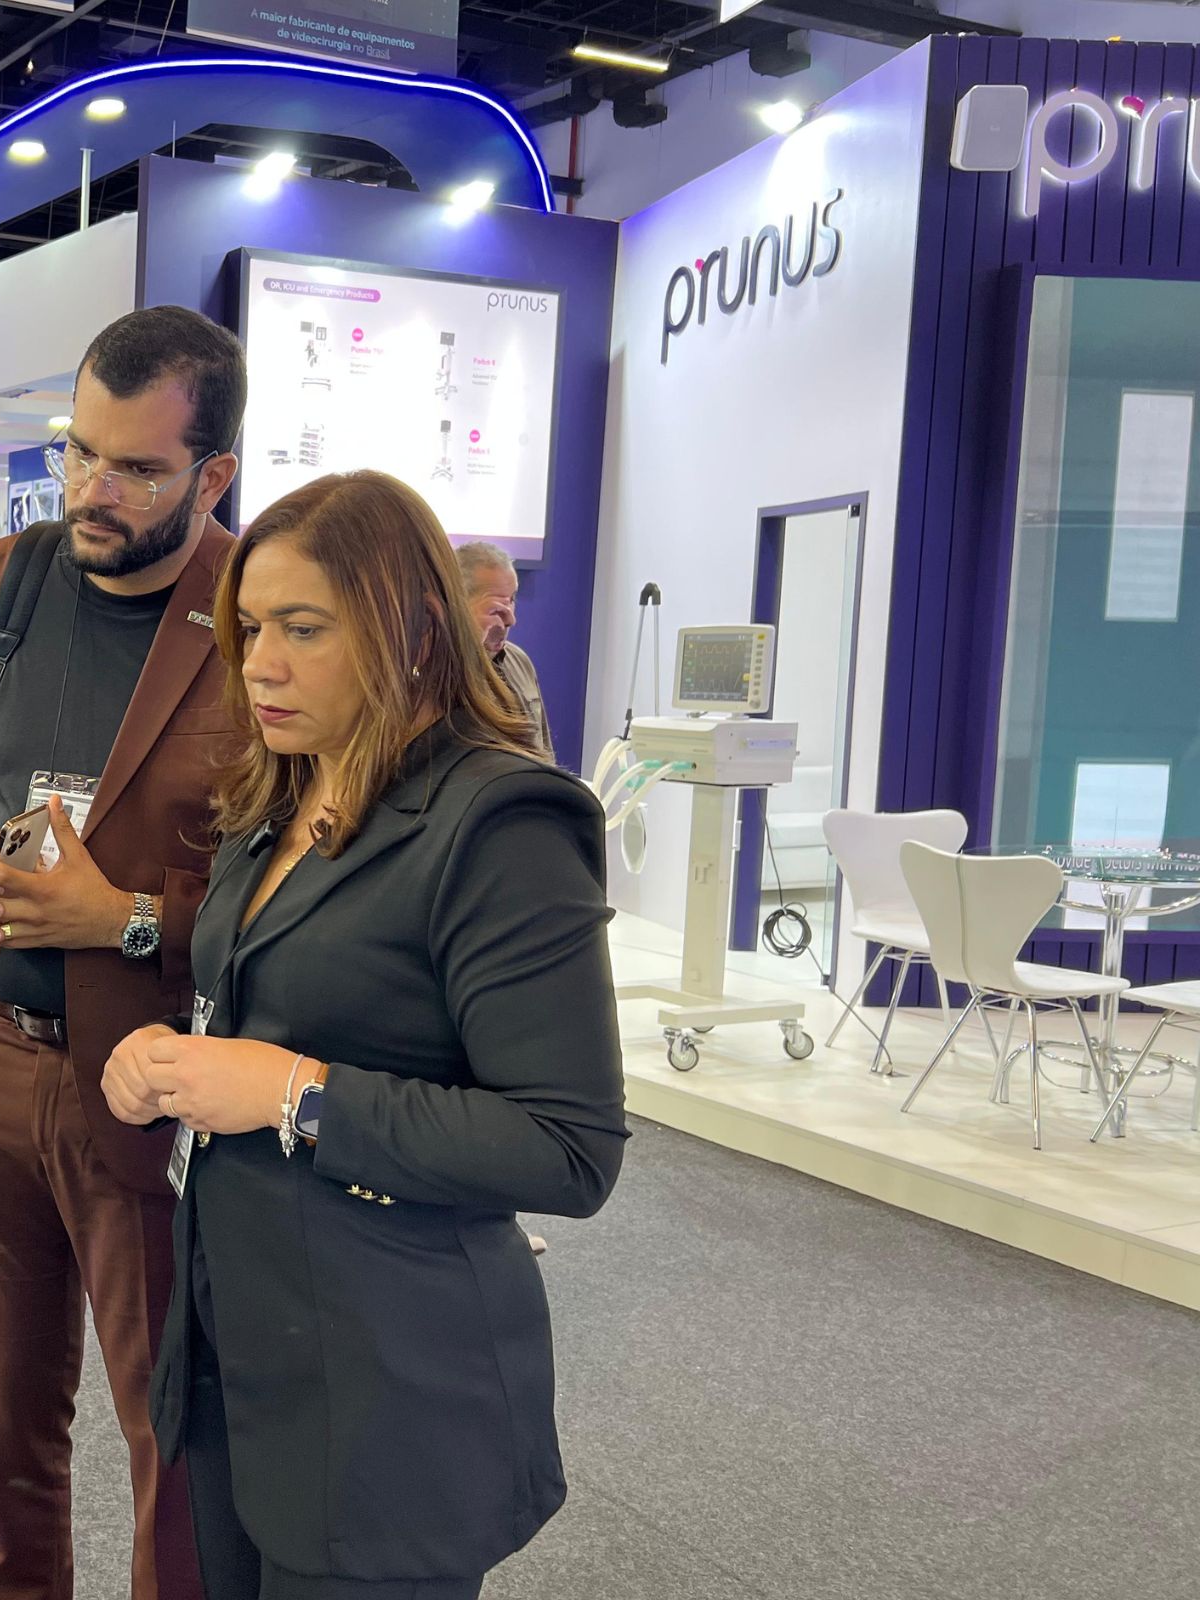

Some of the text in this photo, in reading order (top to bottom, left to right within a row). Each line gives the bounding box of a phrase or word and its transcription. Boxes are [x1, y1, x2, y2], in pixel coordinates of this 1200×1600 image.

[251, 8, 416, 50] A maior fabricante de equipamentos
[277, 28, 289, 38] de
[291, 31, 351, 51] videocirurgia
[353, 45, 365, 54] no
[1022, 87, 1200, 218] pr
[661, 187, 844, 366] prunus
[486, 292, 548, 313] prunus
